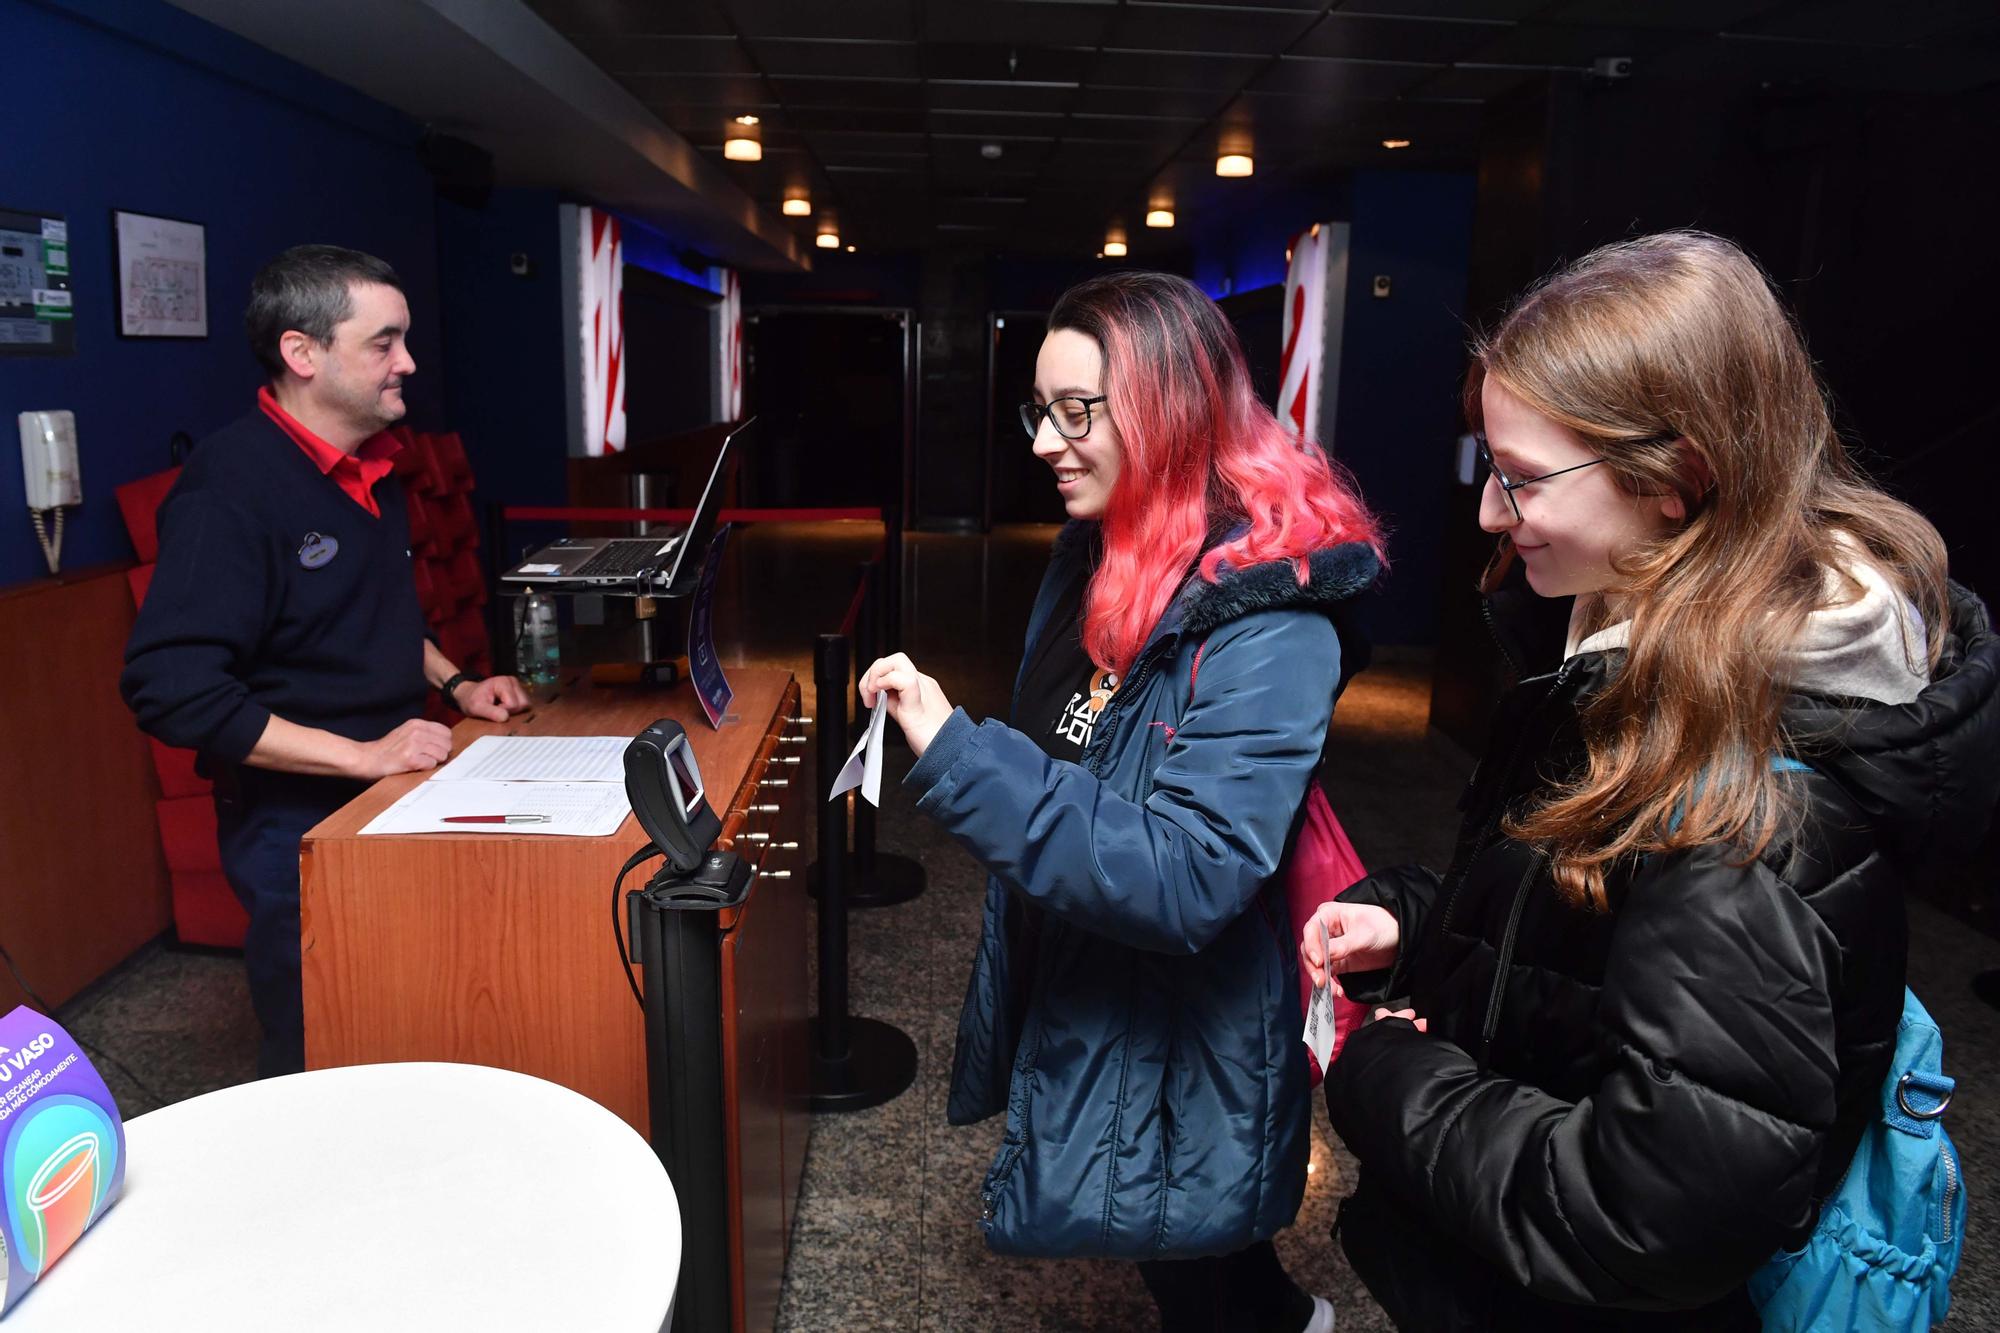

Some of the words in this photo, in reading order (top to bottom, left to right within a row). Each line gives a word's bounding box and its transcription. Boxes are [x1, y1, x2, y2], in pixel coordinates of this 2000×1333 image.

[0, 1063, 12, 1082] U
[8, 1033, 54, 1070] VASO
[5, 1069, 42, 1100] ESCANEAR
